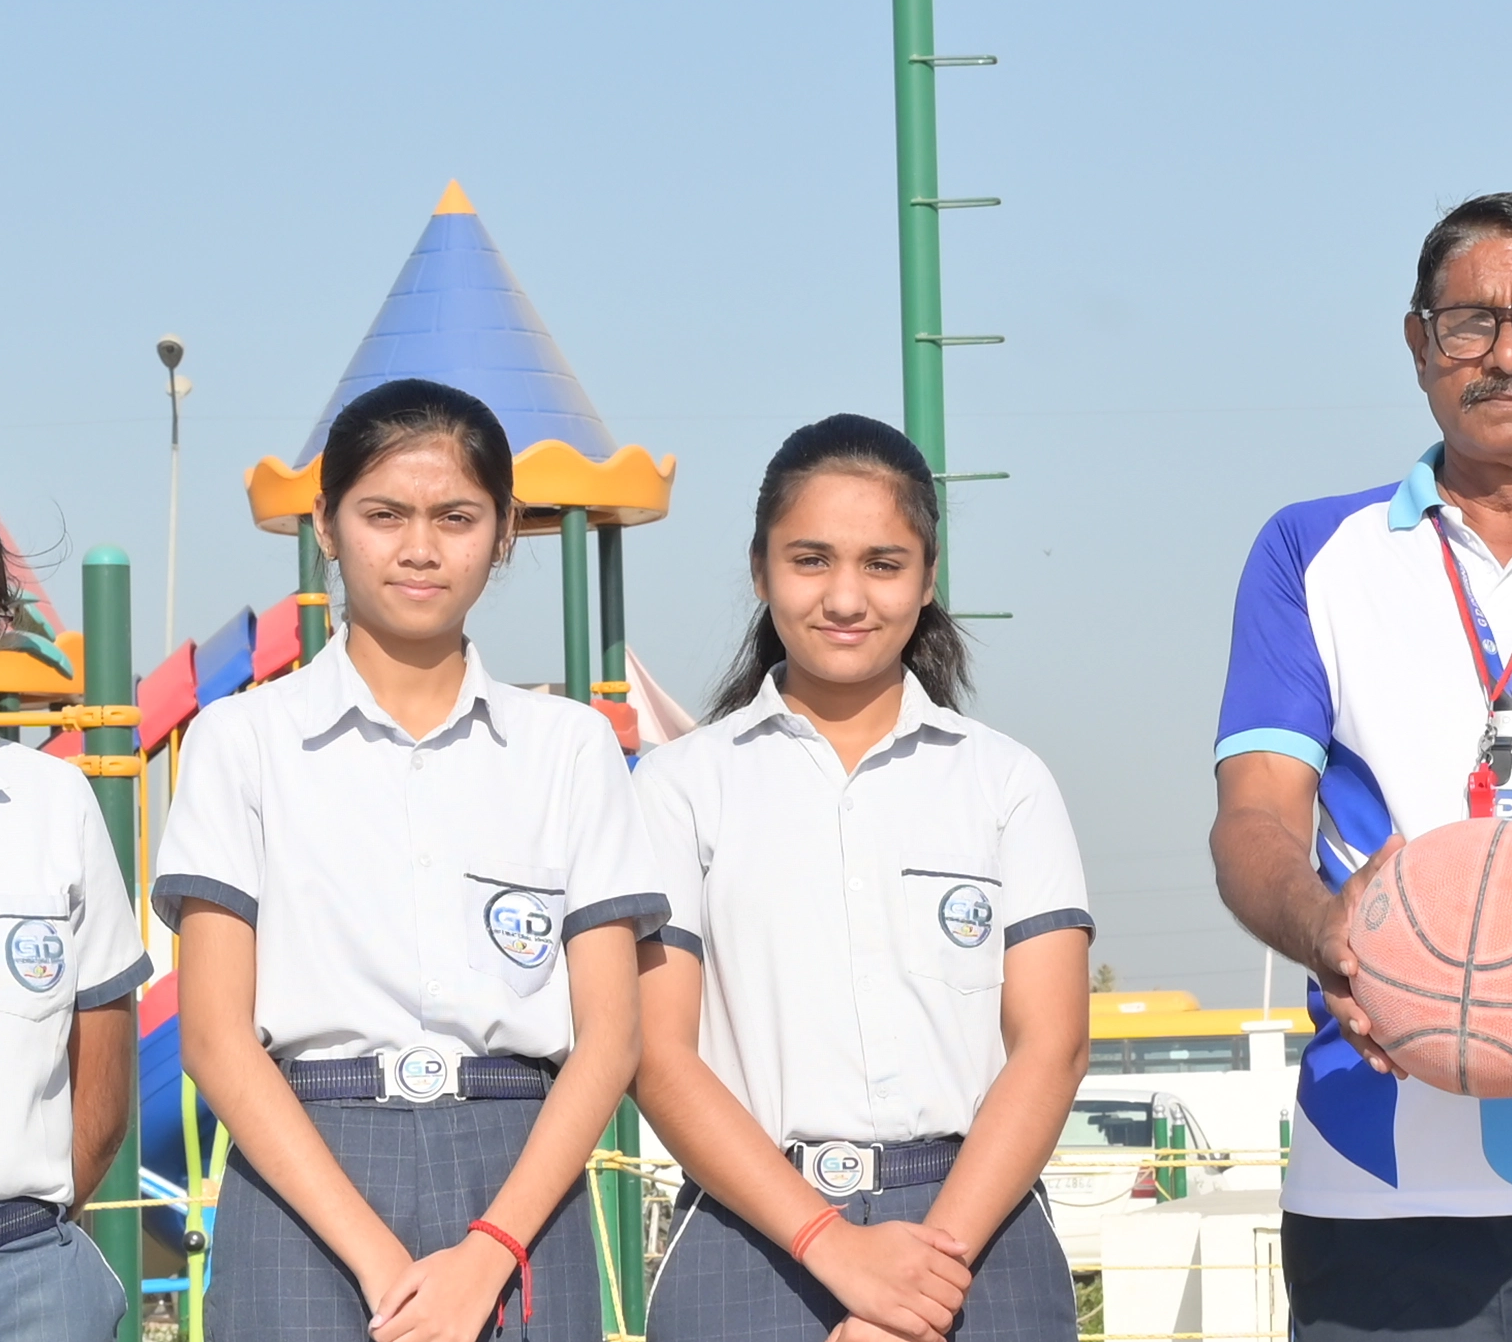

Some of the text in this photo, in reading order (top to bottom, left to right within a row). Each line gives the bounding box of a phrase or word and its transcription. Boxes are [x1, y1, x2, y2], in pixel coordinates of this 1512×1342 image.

[493, 907, 552, 937] GD
[944, 899, 992, 922] GD
[14, 935, 64, 958] GD
[405, 1061, 442, 1075] GD
[823, 1157, 859, 1170] GD
